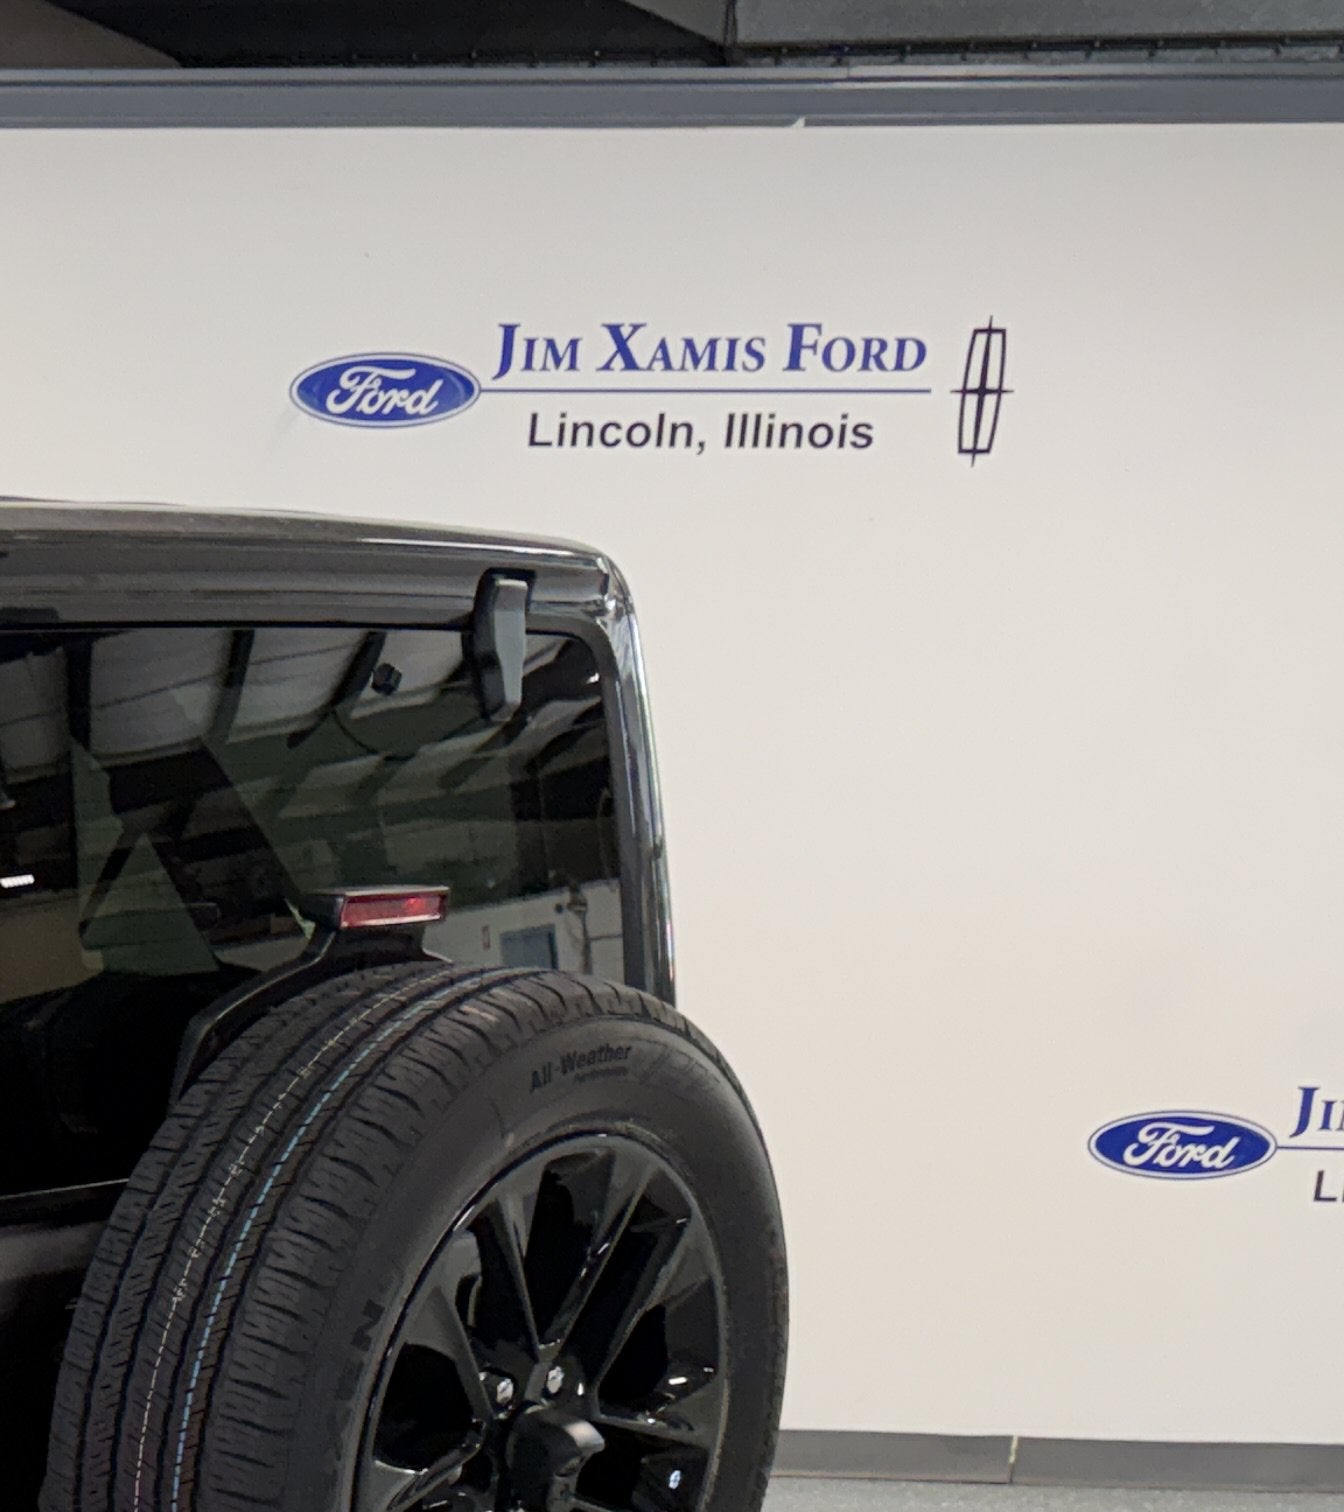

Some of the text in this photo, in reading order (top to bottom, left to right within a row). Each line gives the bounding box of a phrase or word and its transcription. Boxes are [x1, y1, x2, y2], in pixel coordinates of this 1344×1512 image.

[492, 322, 929, 381] JIM XAMIS FORD
[325, 364, 440, 417] Ford
[528, 411, 875, 455] Lincoln, Illinois
[1288, 1086, 1344, 1139] JI
[1122, 1120, 1241, 1170] Ford
